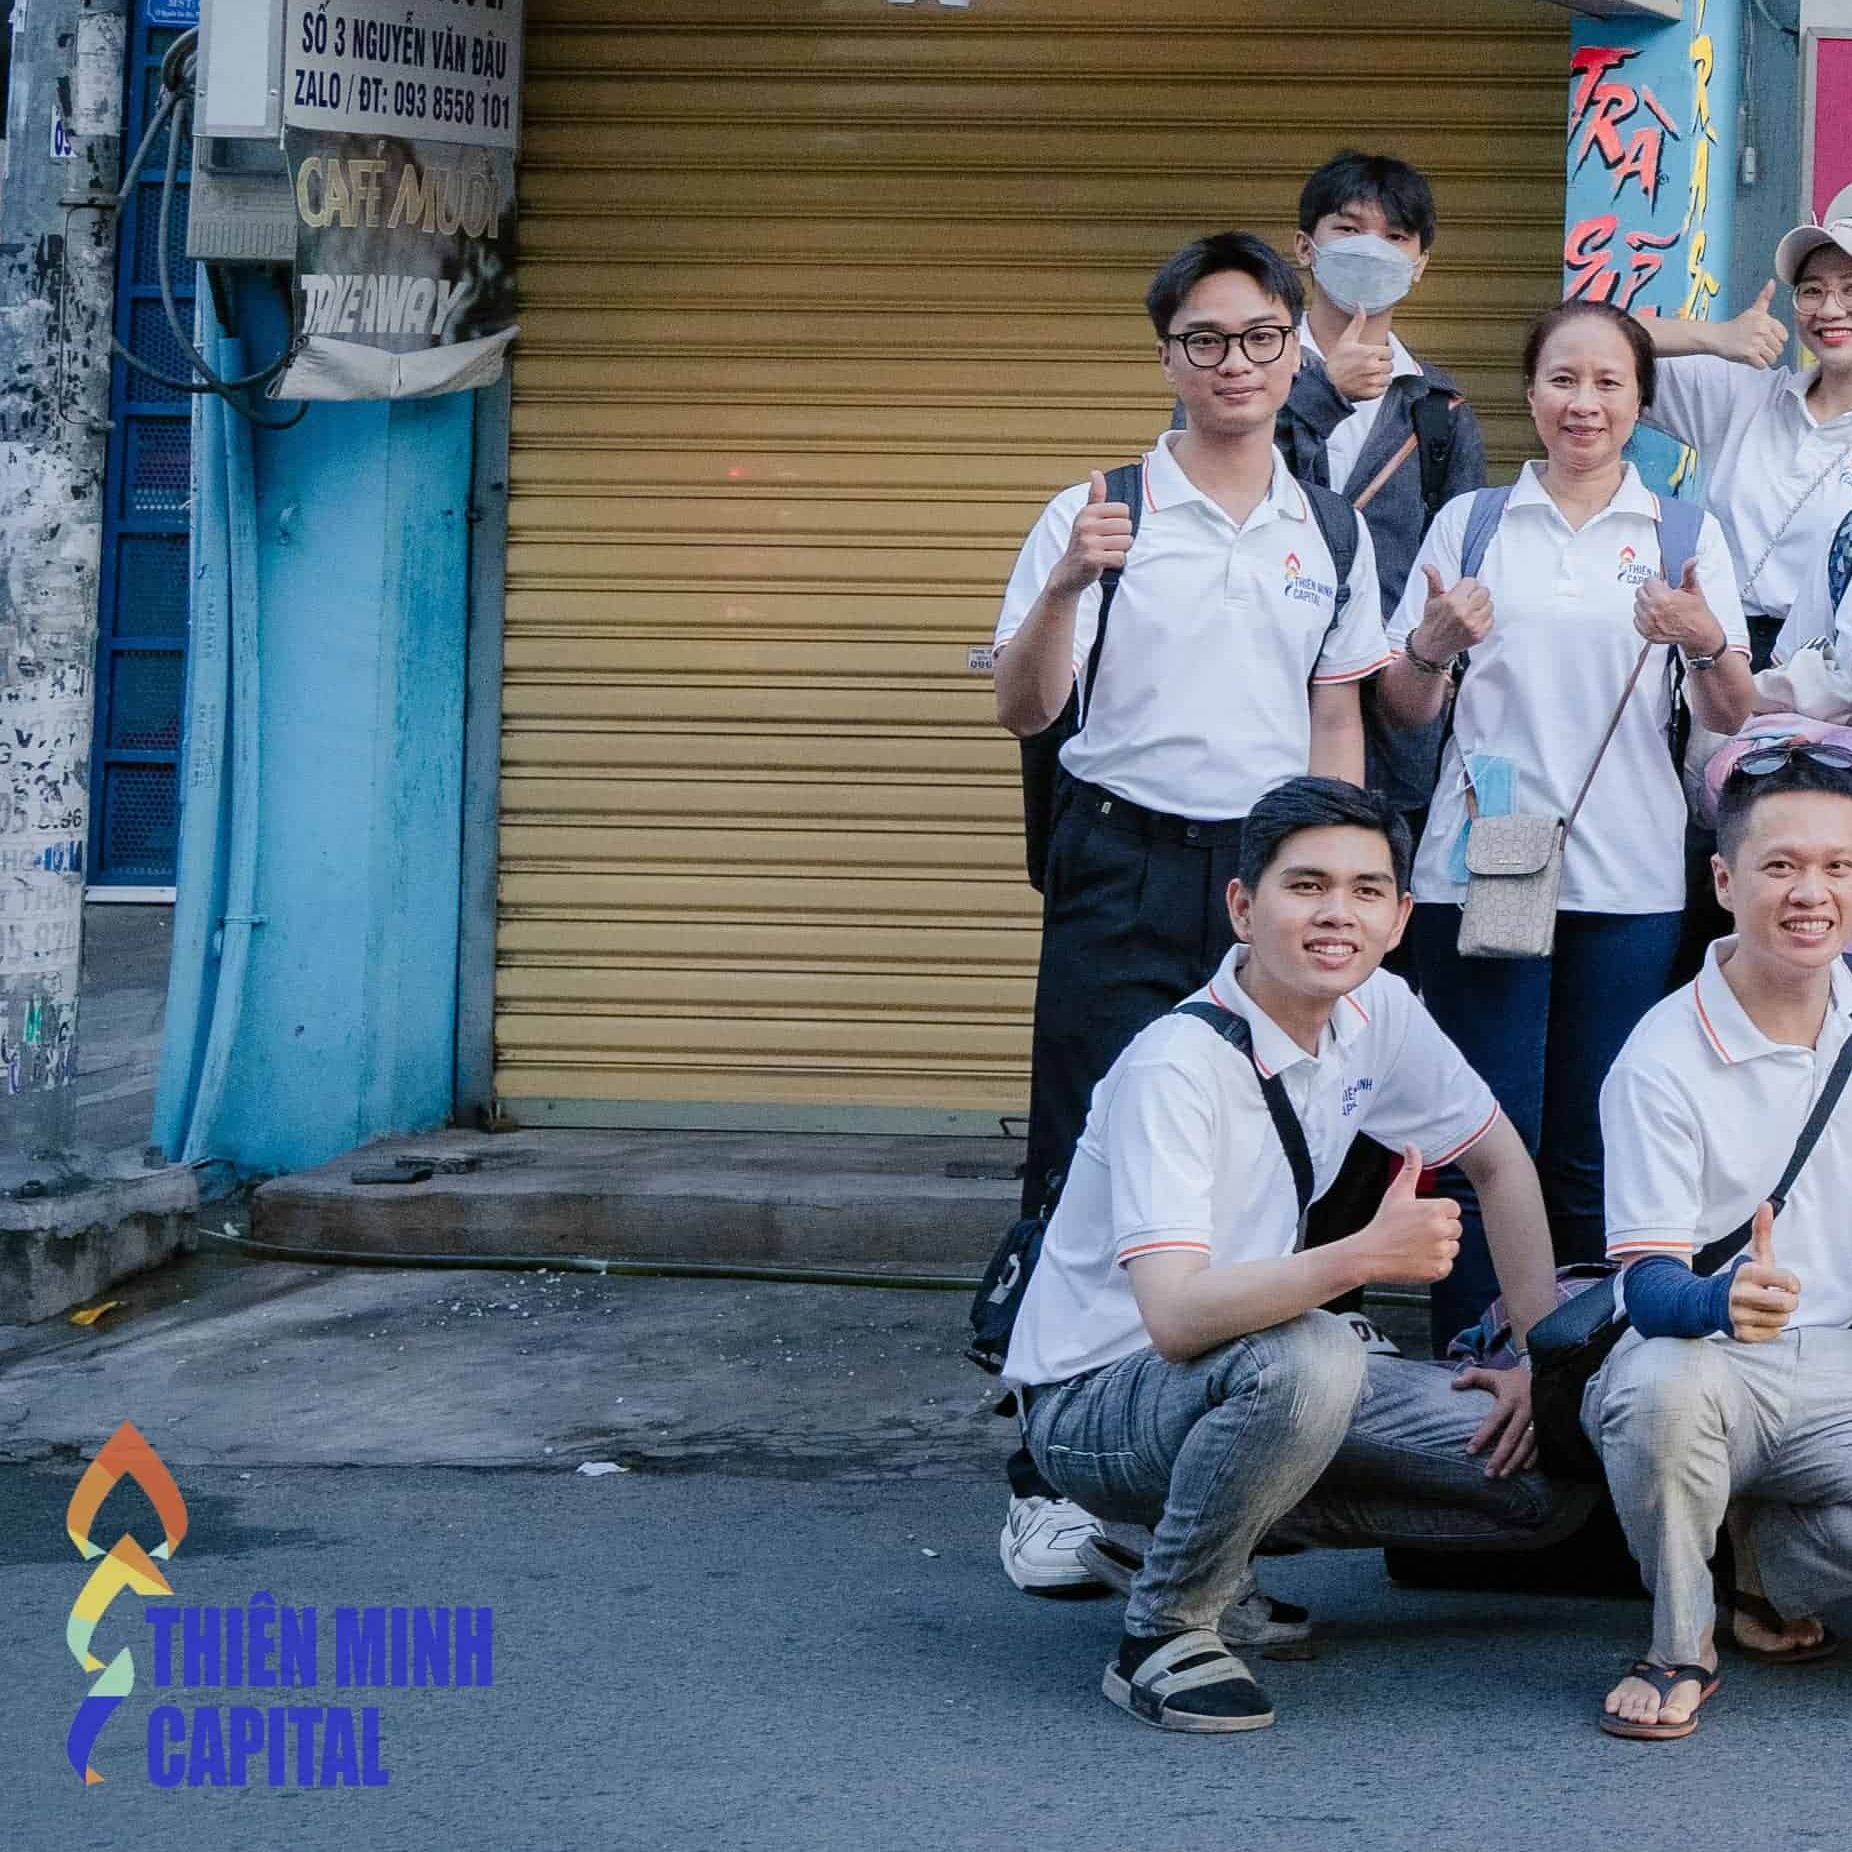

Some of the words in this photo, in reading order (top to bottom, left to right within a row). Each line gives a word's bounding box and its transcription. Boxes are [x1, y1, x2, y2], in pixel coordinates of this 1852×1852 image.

[302, 0, 329, 54] SỐ
[334, 16, 347, 58] 3
[352, 10, 425, 68] NGUYỄN
[431, 25, 467, 74] VĂN
[471, 30, 507, 89] ĐẬU
[294, 68, 342, 110] ZALO
[358, 75, 388, 115] ĐT:
[393, 80, 427, 119] 093
[432, 87, 475, 125] 8558
[481, 92, 510, 130] 101
[295, 139, 387, 229] CAFÉ
